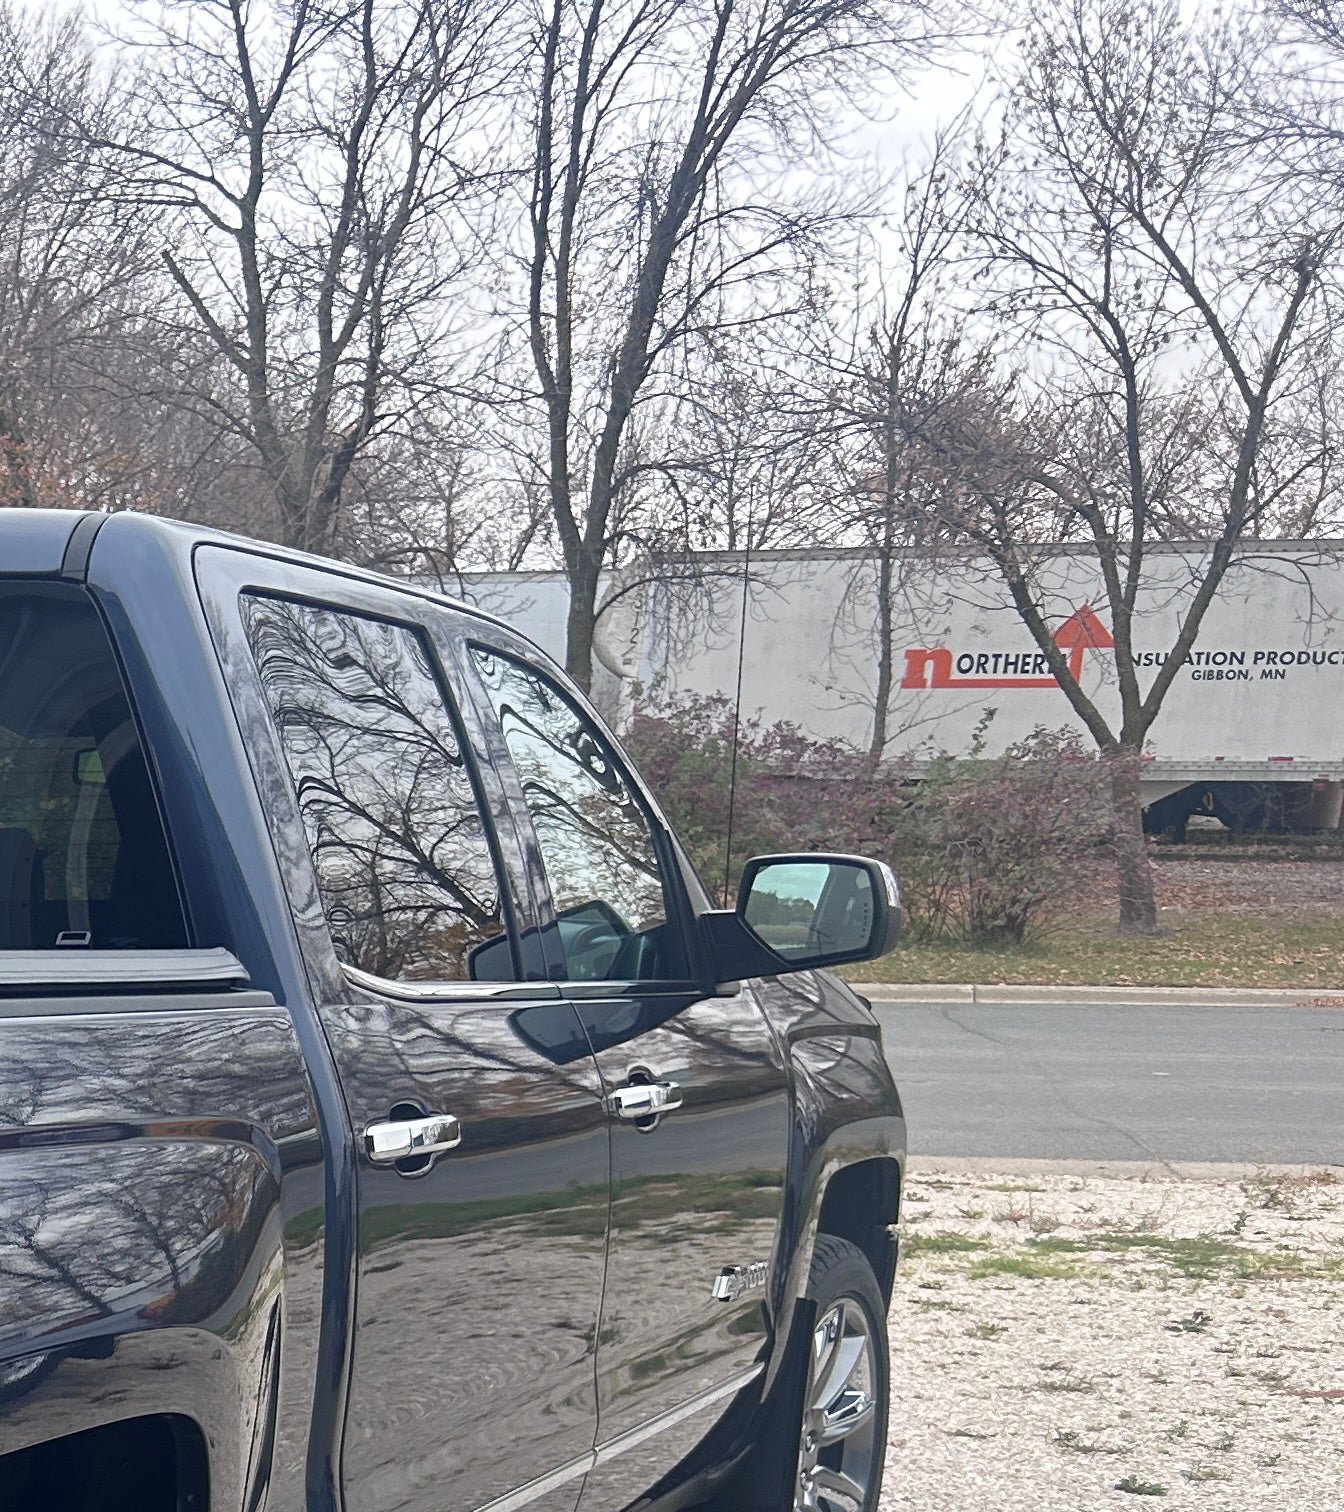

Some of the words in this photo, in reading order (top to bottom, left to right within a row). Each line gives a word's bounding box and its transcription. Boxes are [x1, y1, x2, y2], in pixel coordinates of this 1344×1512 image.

[1253, 651, 1344, 666] PRODUC
[1191, 668, 1254, 682] GIBBON,
[1260, 668, 1286, 680] MN
